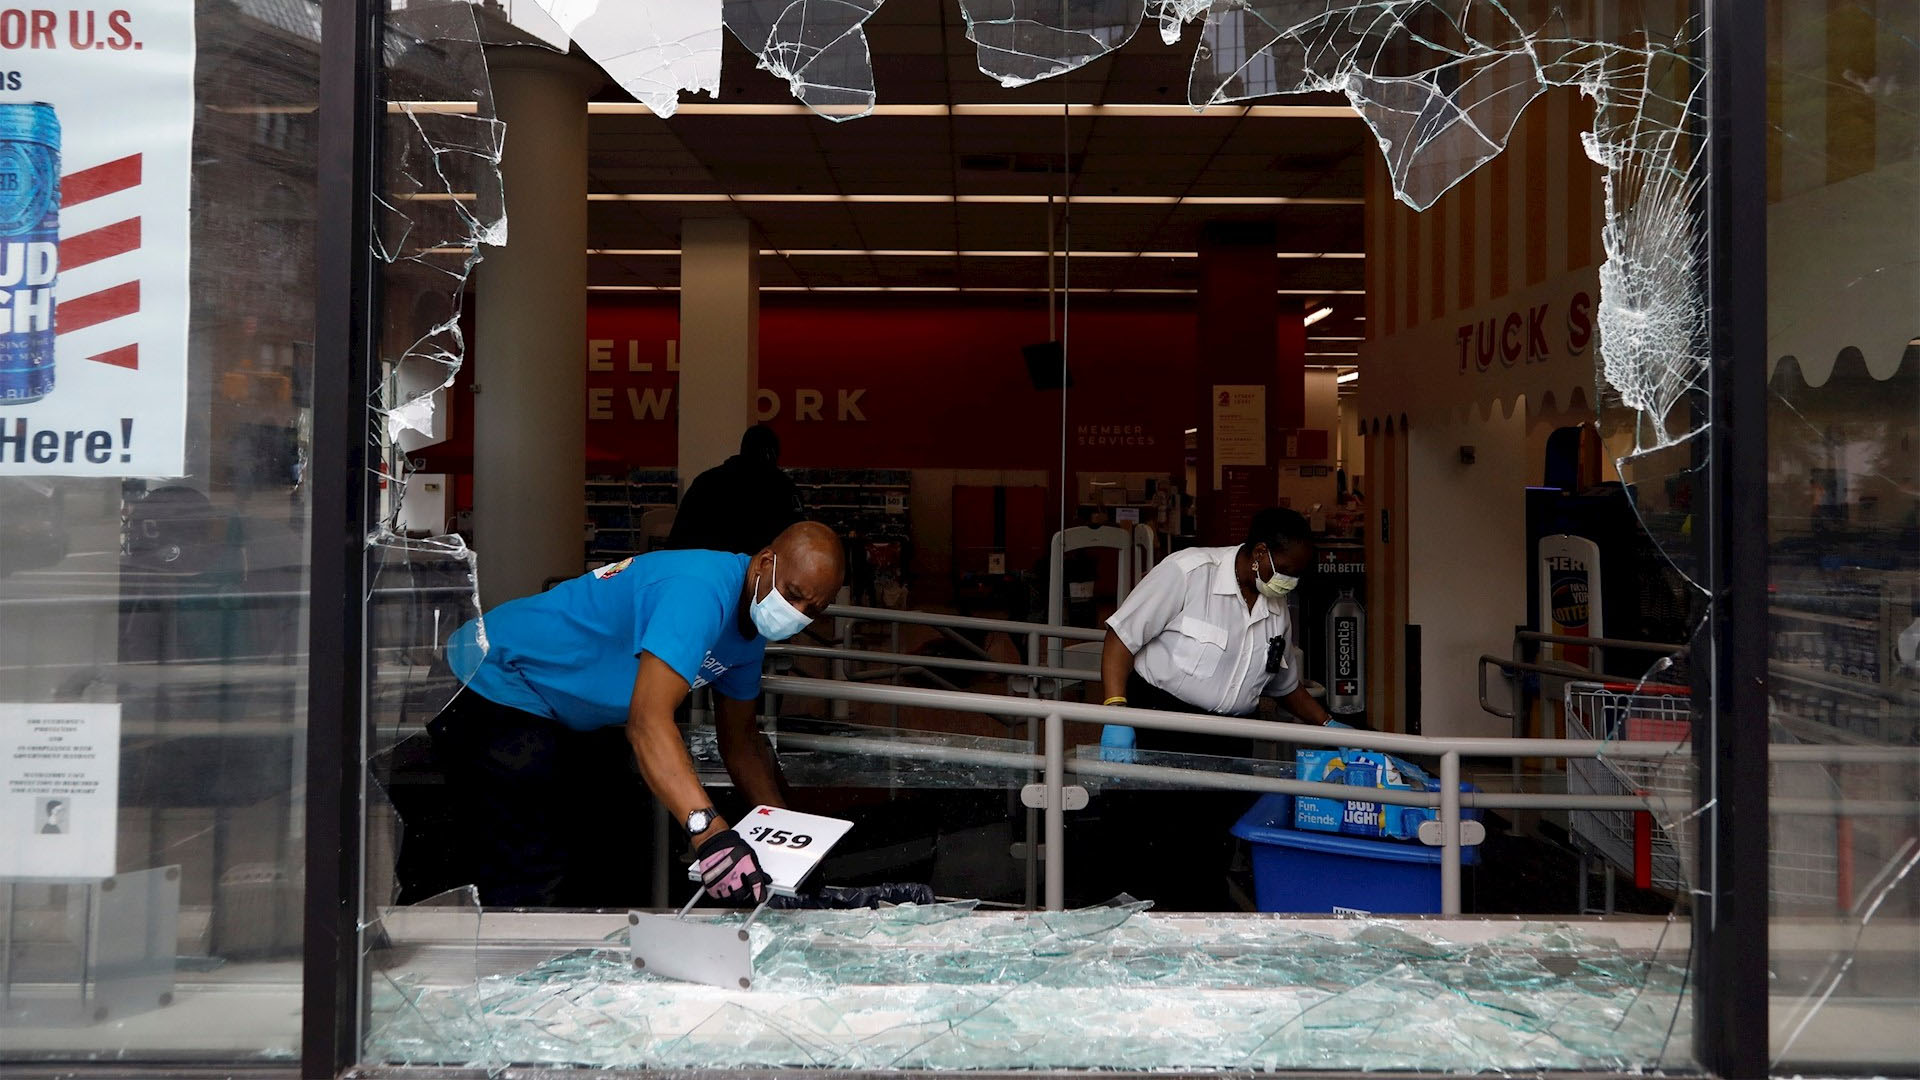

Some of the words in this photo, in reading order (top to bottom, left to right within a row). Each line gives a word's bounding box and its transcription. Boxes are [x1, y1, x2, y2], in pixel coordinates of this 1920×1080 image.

[68, 9, 143, 51] U.S.
[1457, 303, 1549, 375] TUCK
[1077, 424, 1144, 434] MEMBER
[0, 417, 134, 464] Here!
[1077, 435, 1156, 446] SERVICES
[1317, 562, 1337, 574] FOR
[1337, 620, 1351, 676] essentia
[1298, 799, 1319, 812] Fun.
[1298, 812, 1338, 826] Friends.
[1343, 810, 1378, 826] LIGHT
[750, 826, 812, 849] $159
